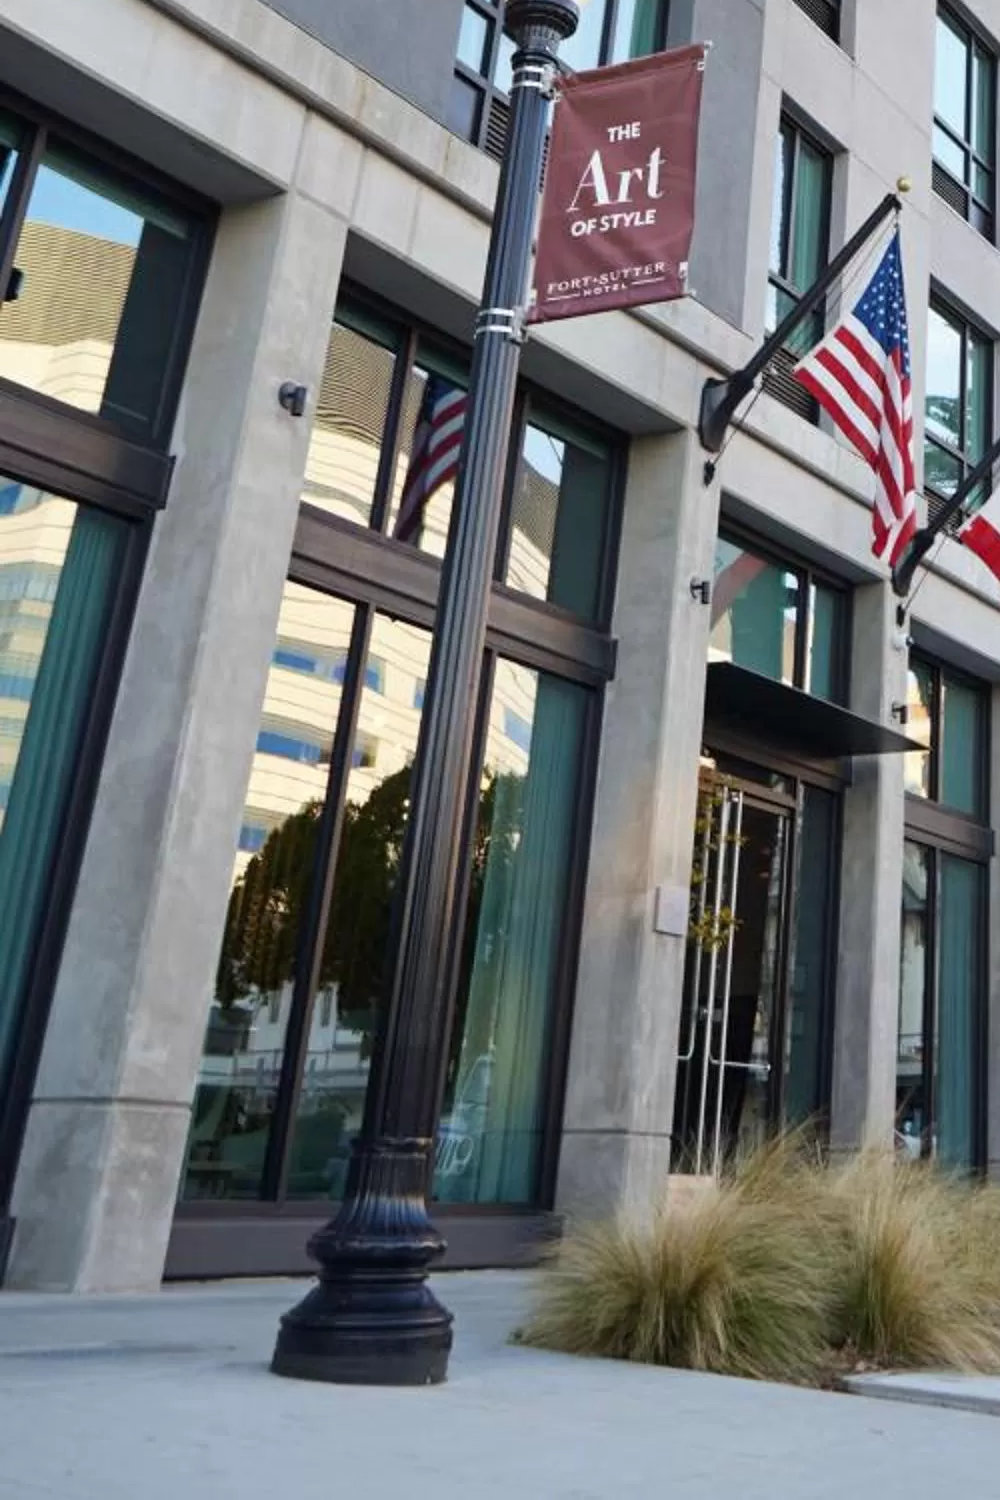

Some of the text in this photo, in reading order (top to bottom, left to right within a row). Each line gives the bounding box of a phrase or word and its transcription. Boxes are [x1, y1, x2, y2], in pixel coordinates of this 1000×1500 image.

[607, 121, 641, 143] THE
[565, 146, 667, 213] Art
[571, 209, 657, 237] OF STYLE
[583, 282, 629, 298] HOTEL
